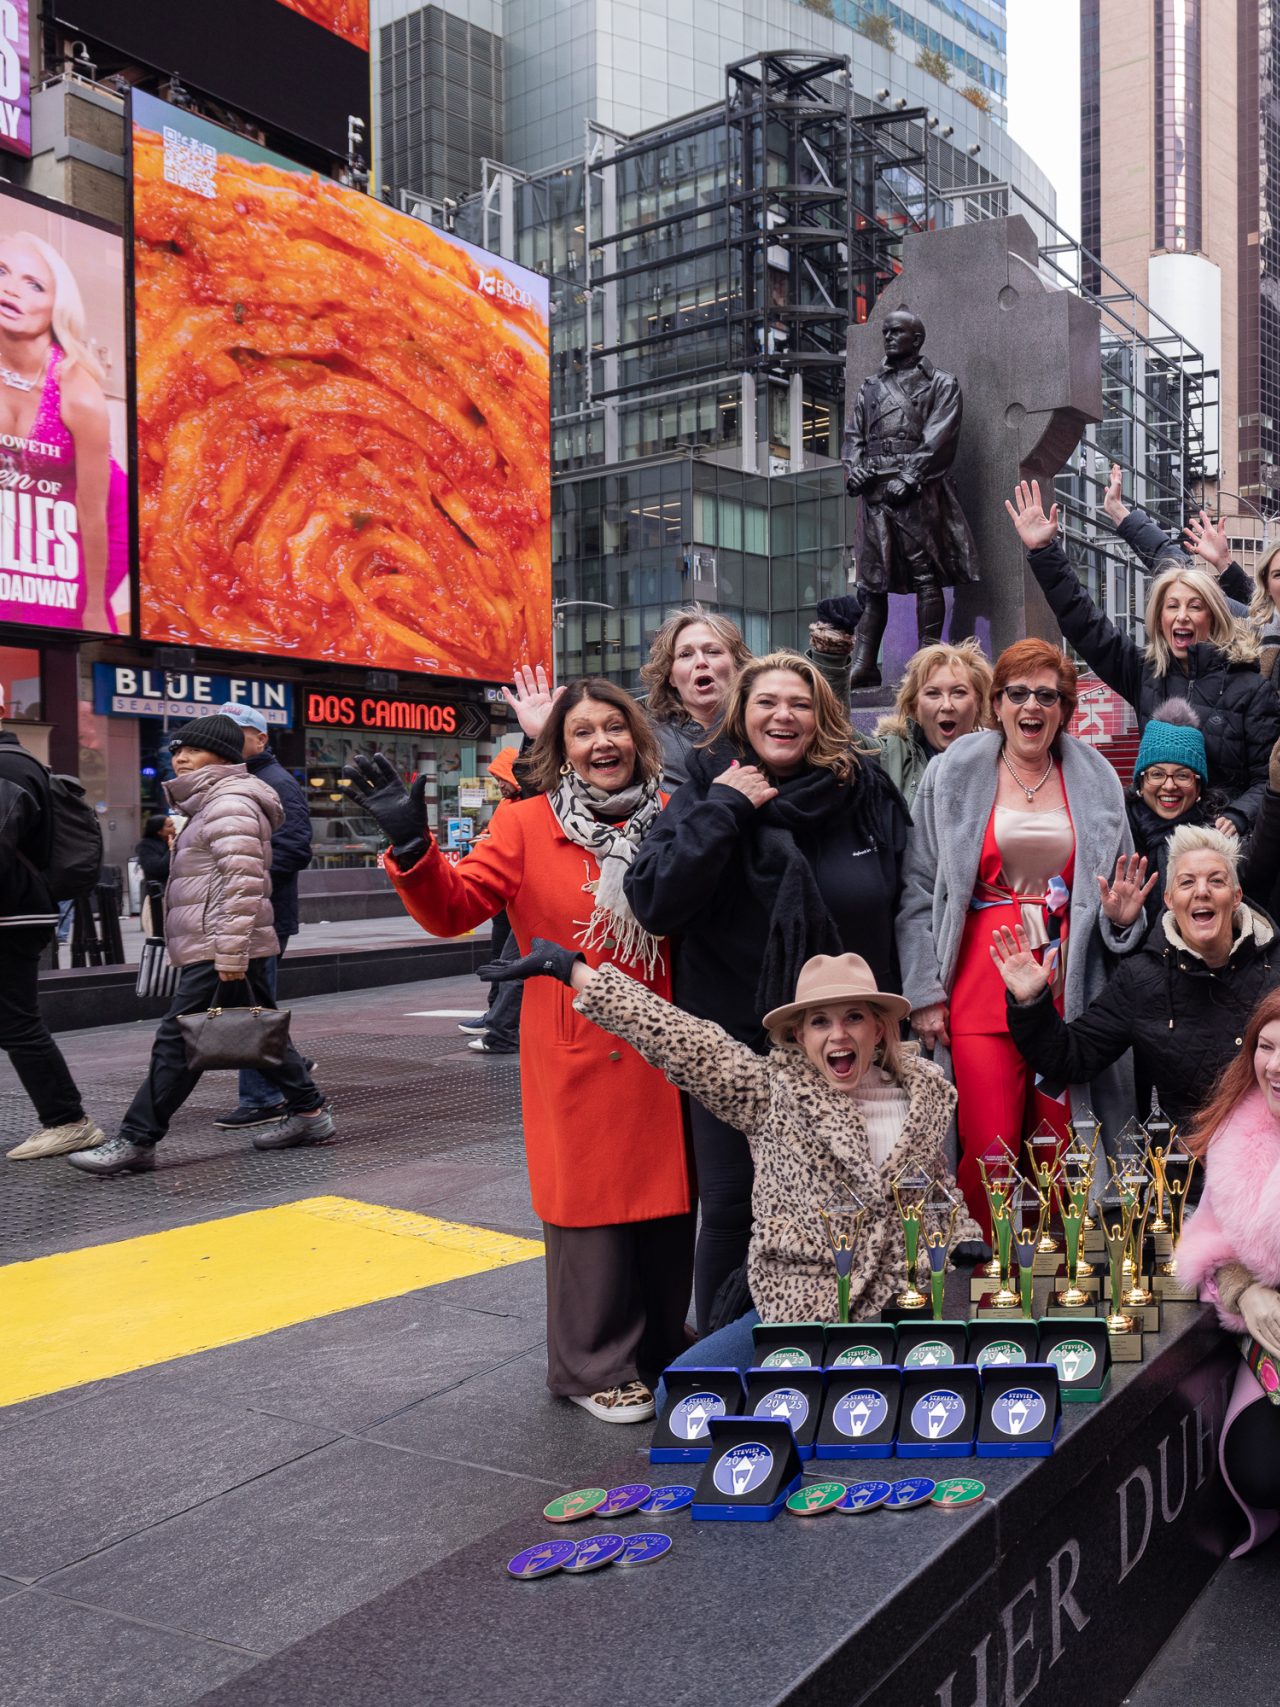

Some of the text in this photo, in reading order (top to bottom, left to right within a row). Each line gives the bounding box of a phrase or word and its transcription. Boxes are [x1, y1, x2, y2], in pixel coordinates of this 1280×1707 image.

[0, 433, 61, 458] OWETH
[37, 479, 62, 496] OF
[0, 490, 79, 580] LLES
[115, 667, 286, 708] BLUE FIN
[116, 699, 209, 715] SEAFOOD
[307, 693, 457, 733] DOS CAMINOS
[680, 1402, 719, 1413] 20 25
[765, 1399, 803, 1410] 20 25
[842, 1399, 881, 1409] 20 25
[921, 1400, 959, 1410] 20 25
[1002, 1398, 1039, 1407] 20 25
[725, 1451, 766, 1466] 20 25
